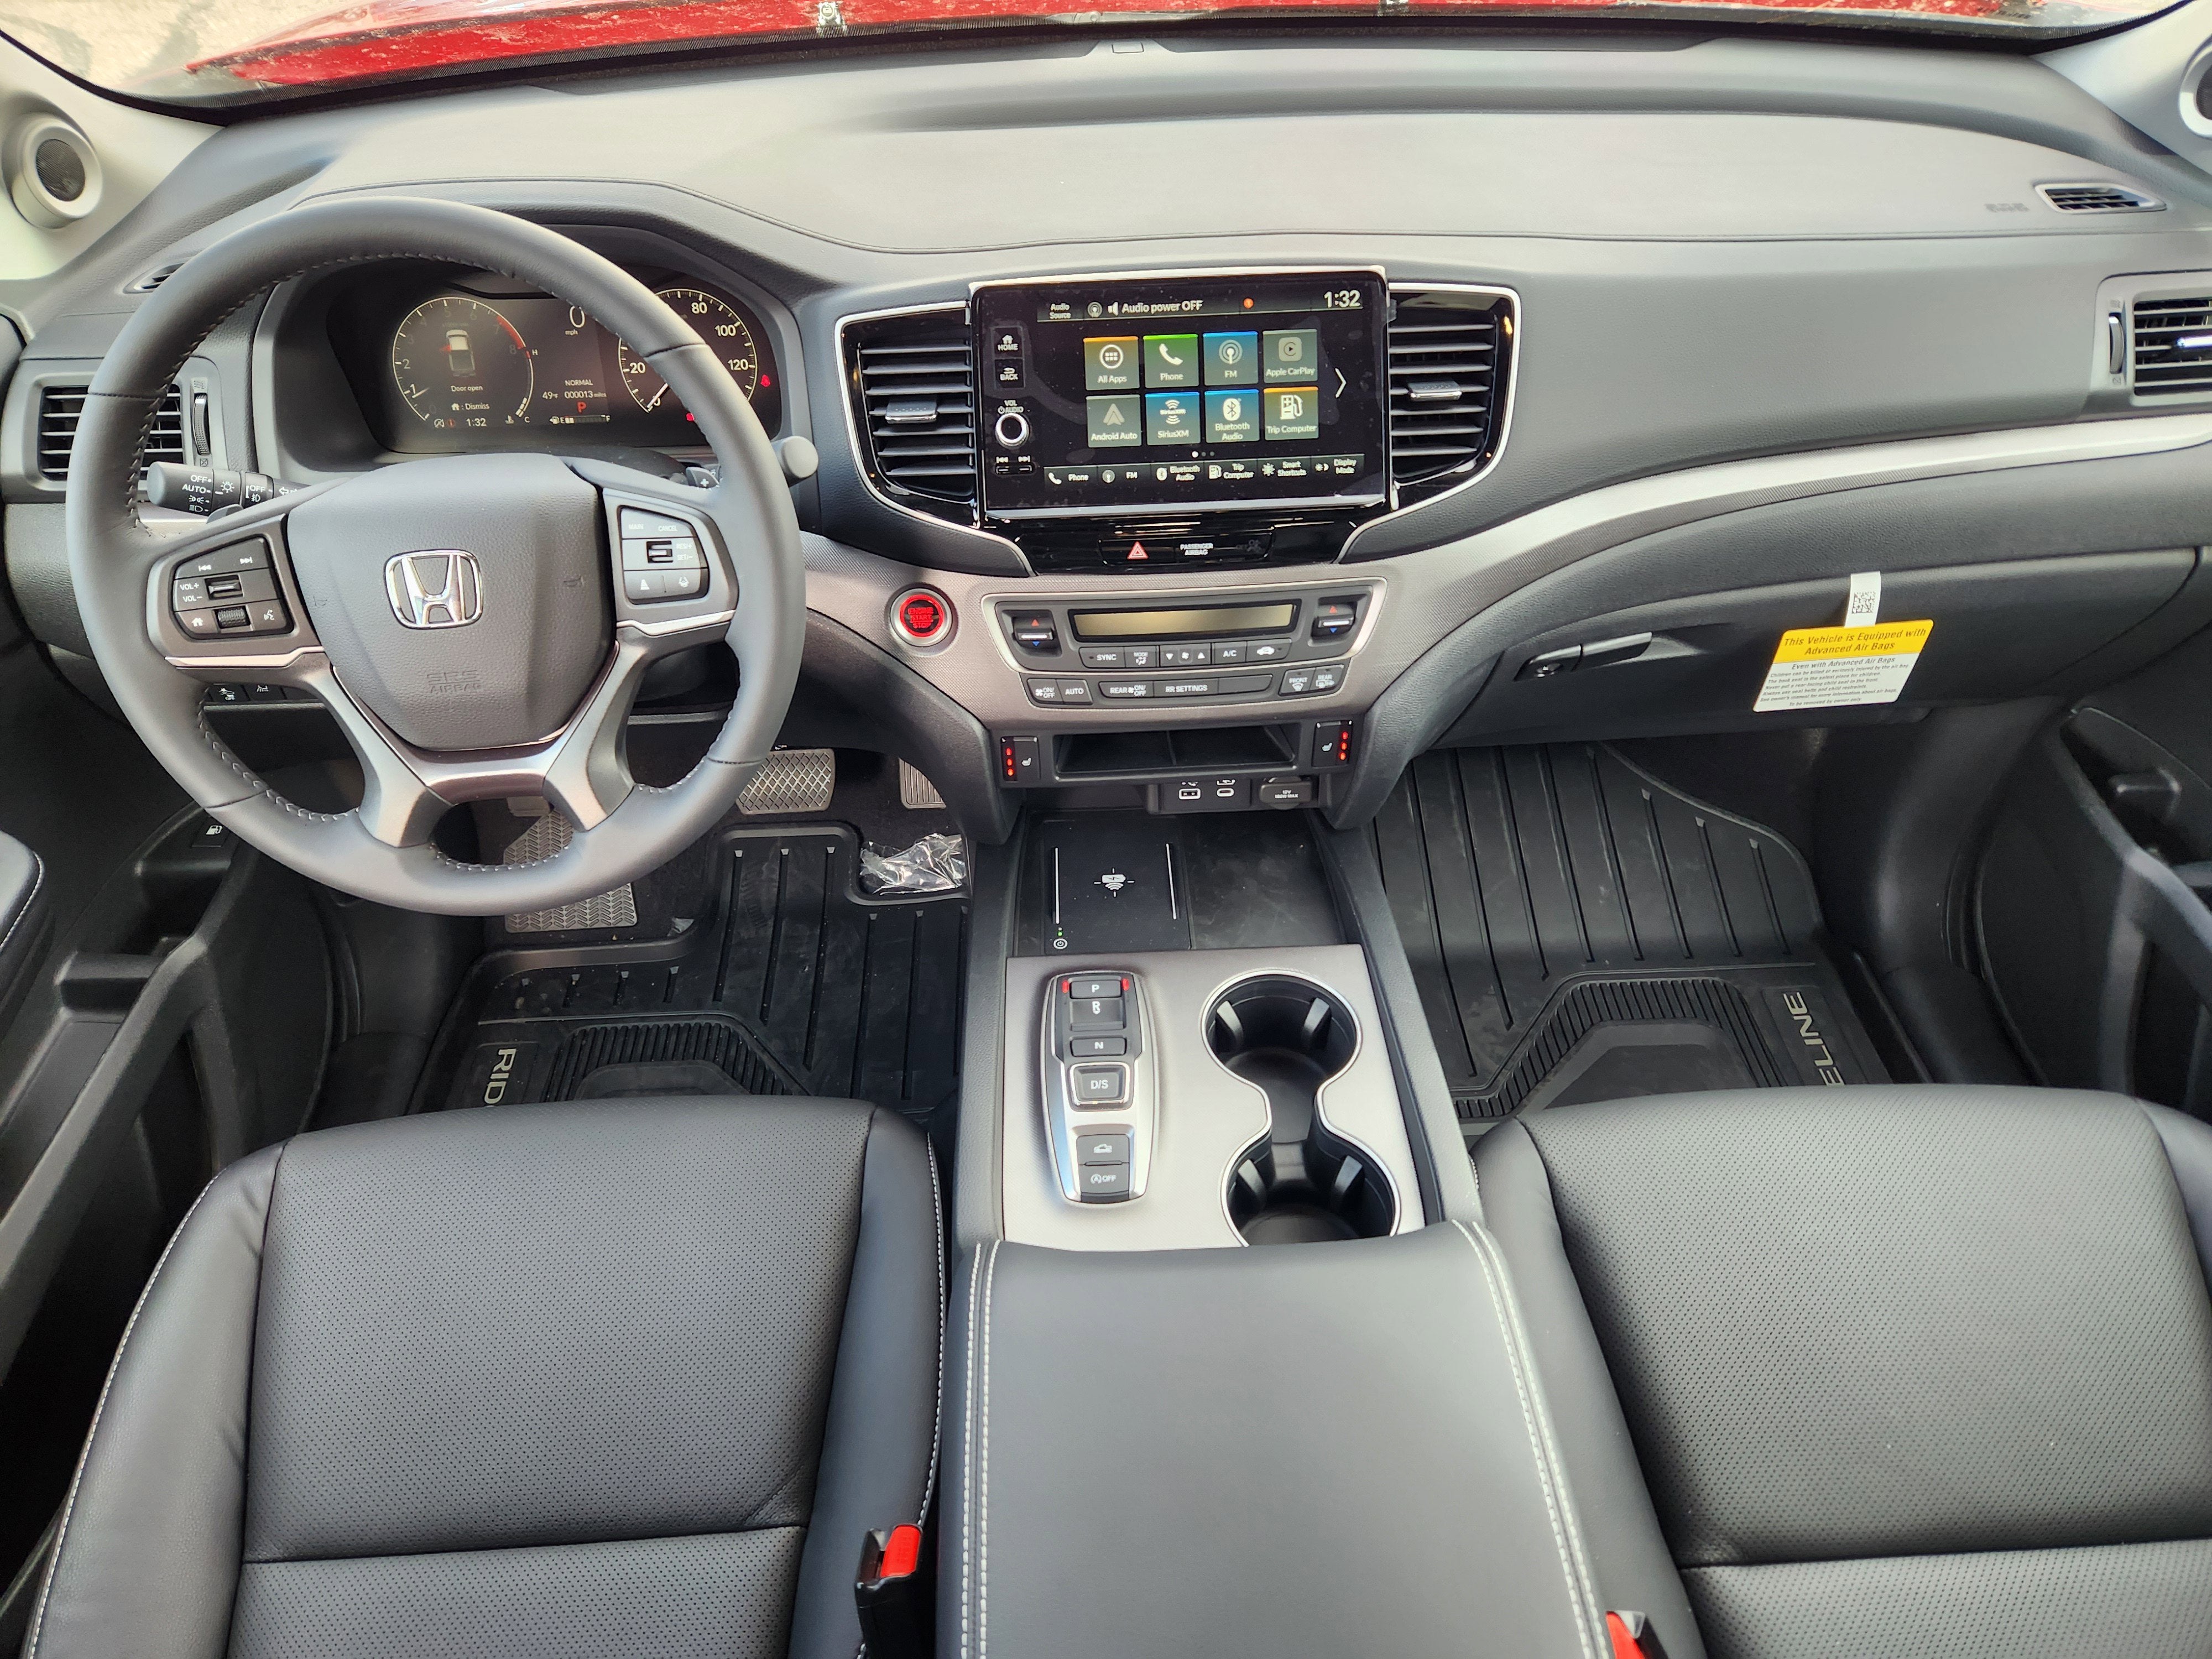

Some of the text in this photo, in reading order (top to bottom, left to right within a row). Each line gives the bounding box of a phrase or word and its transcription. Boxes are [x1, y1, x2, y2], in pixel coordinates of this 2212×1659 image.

[1324, 290, 1361, 309] 1:32
[691, 302, 708, 314] 80
[1121, 300, 1203, 315] Audio power OFF
[570, 306, 585, 328] 0
[714, 325, 736, 337] 100
[403, 359, 411, 369] 2
[629, 362, 646, 373] 20
[728, 359, 749, 371] 120
[1160, 373, 1184, 382] Phone
[1225, 370, 1238, 378] FM
[1266, 367, 1316, 378] Apple CarPlay
[1098, 375, 1128, 385] All Apps
[410, 383, 416, 394] 1
[564, 390, 593, 399] 000013
[577, 401, 587, 413] P
[466, 418, 487, 427] 1:32
[1215, 422, 1250, 431] Bluetooth
[1157, 430, 1190, 439] SiriusXM
[1266, 424, 1317, 435] Trip Computer
[1091, 432, 1138, 441] Android Auto
[1222, 432, 1243, 441] Audio
[182, 484, 206, 494] AUTO
[1785, 638, 1804, 646] This
[1808, 634, 1843, 644] Vehicle
[1858, 629, 1903, 641] Equipped
[1906, 628, 1926, 637] with
[1804, 642, 1895, 655] Advanced Air Bags
[1828, 659, 1864, 667] Advanced
[1091, 984, 1100, 993] P
[1094, 1041, 1104, 1050] N
[484, 1048, 517, 1104] RID
[1091, 1079, 1109, 1090] D/S
